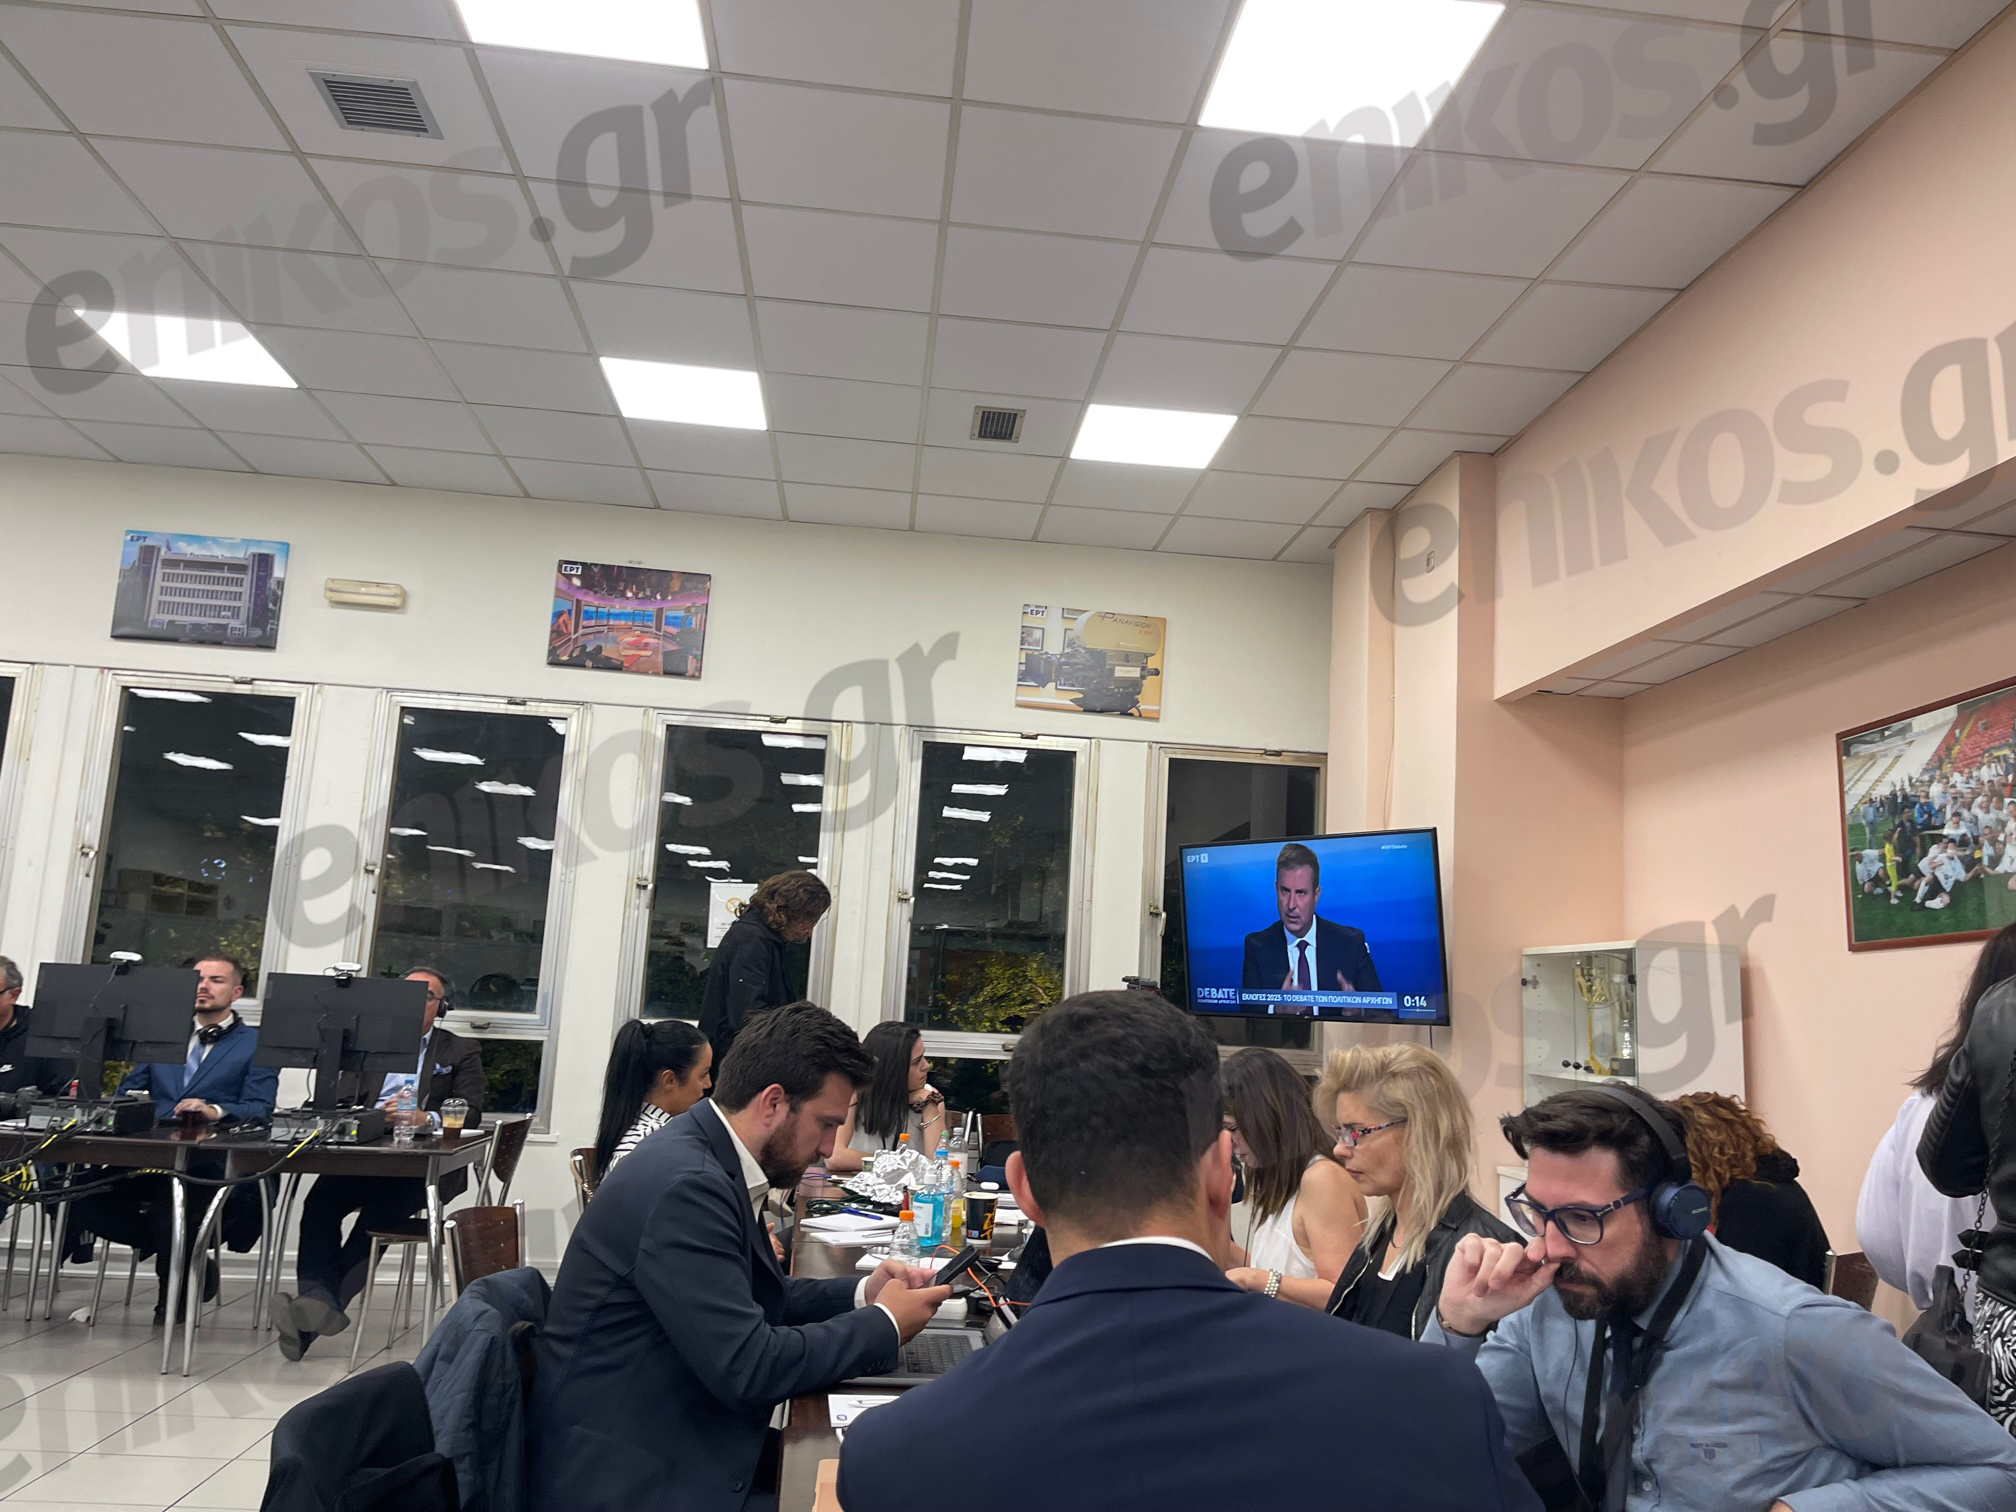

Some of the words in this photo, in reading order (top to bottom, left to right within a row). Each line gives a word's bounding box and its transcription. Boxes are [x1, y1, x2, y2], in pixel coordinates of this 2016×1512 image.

[564, 566, 580, 574] ΕΡΤ
[1029, 609, 1046, 617] ΕΡΤ
[1098, 612, 1151, 629] PANAVISION
[1197, 988, 1236, 999] DEBATE
[1242, 993, 1267, 1001] ΕΚΛΟΓΕΣ
[1283, 994, 1292, 1002] ΤΟ
[1292, 994, 1315, 1003] DEBATE
[1315, 995, 1328, 1003] ΤΩΝ
[1328, 995, 1362, 1004] ΠΟΛΙΤΙΚΩΝ
[1362, 996, 1393, 1005] ΑΡΧΗΓΩΝ
[1404, 995, 1427, 1007] 0:14
